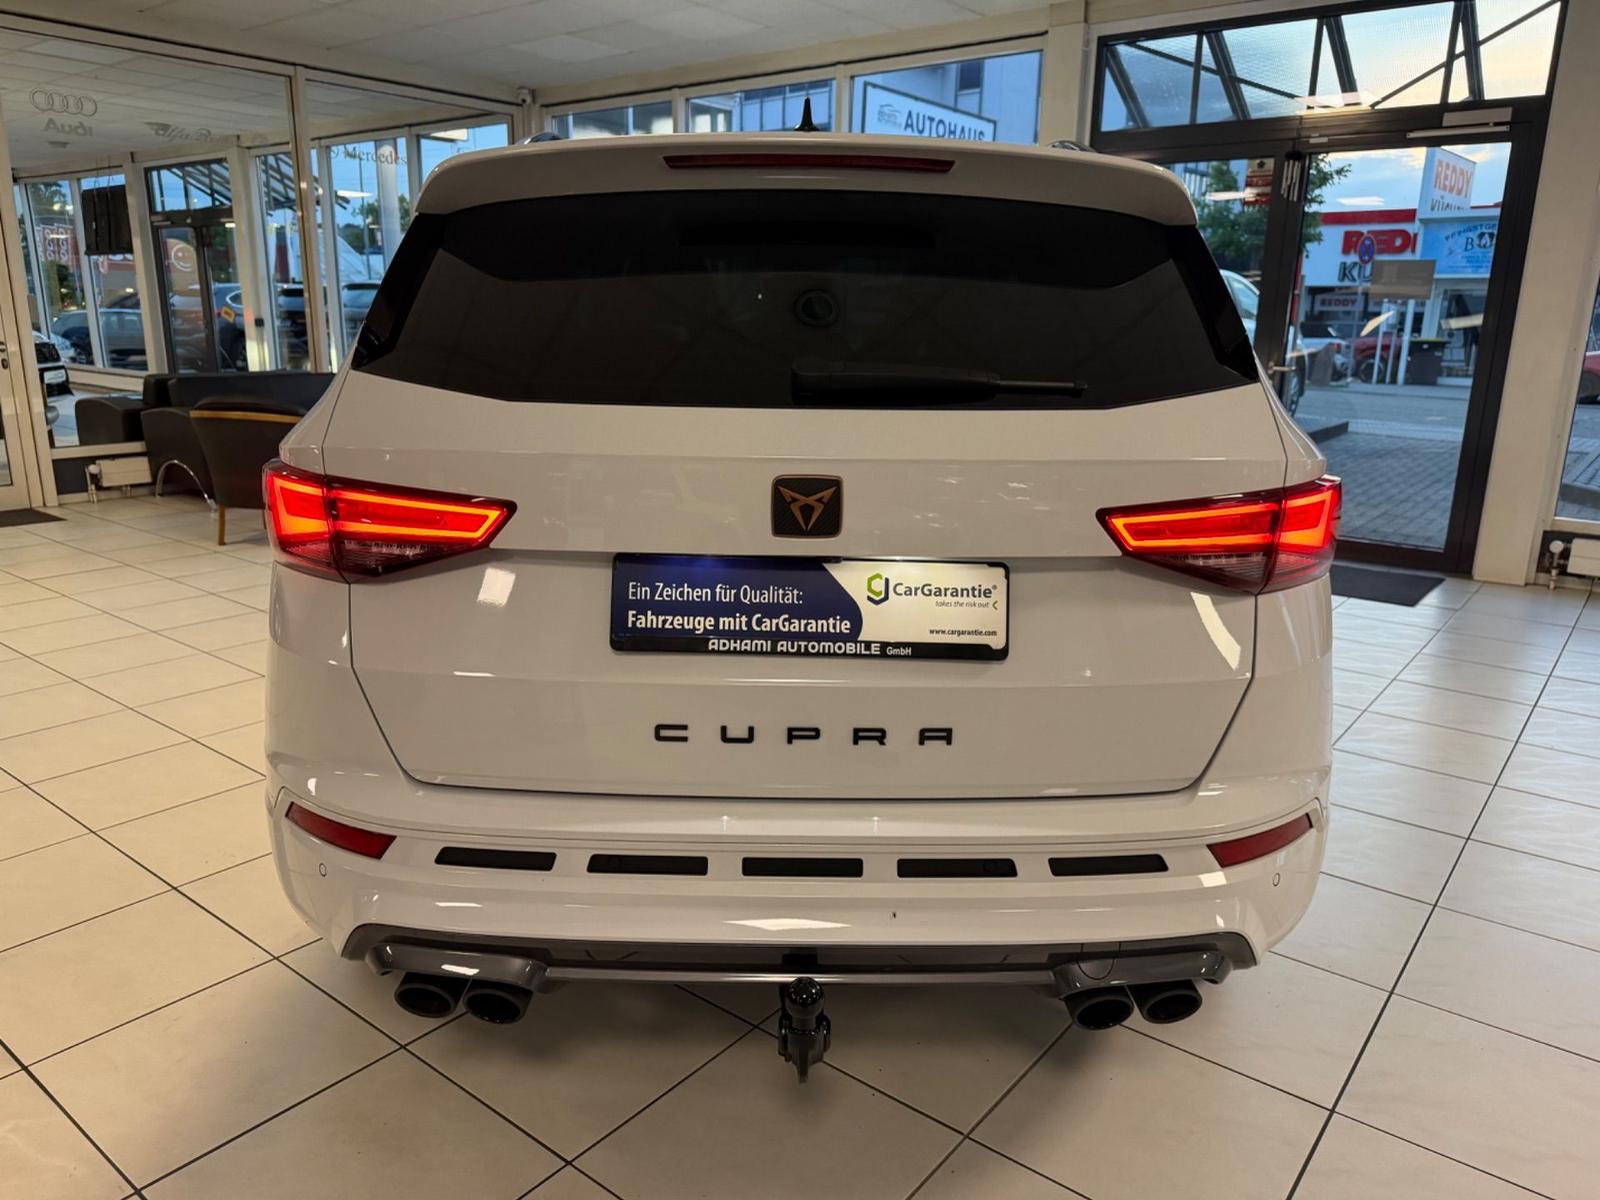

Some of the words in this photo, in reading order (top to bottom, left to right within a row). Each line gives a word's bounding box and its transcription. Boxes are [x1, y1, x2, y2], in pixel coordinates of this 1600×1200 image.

[1434, 159, 1473, 198] REDDY
[628, 581, 650, 601] Ein
[655, 582, 711, 602] Zeichen
[715, 583, 737, 603] für
[740, 584, 804, 605] Qualität:
[935, 600, 952, 608] takes
[953, 600, 965, 608] the
[965, 600, 977, 608] risk
[627, 610, 715, 635] Fahrzeuge
[719, 613, 748, 631] mit
[751, 613, 852, 634] CarGarantie
[929, 628, 998, 638] www.cargarantie.com
[708, 639, 772, 652] ADHAMI
[777, 640, 881, 656] AUTOMOBILE
[886, 646, 912, 657] GmbH
[654, 723, 953, 746] CUPRA
